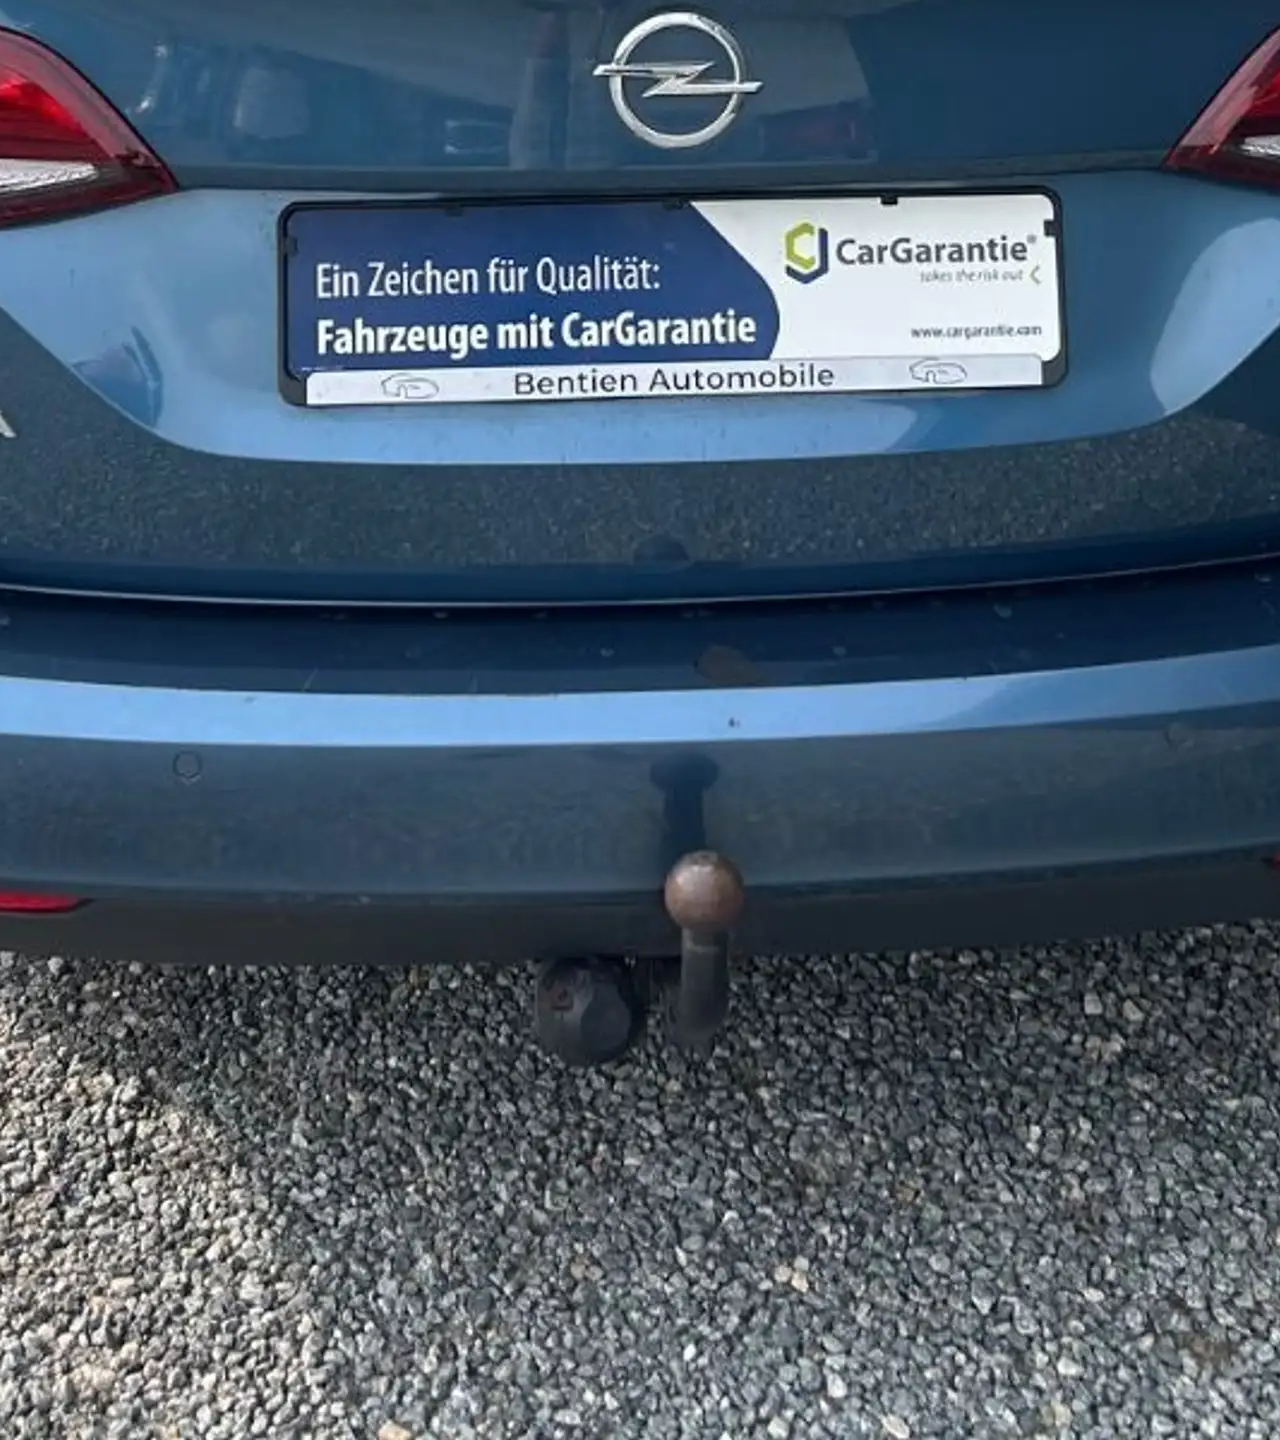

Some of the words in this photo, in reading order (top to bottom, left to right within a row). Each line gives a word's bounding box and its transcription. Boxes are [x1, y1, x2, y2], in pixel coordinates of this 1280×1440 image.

[316, 263, 360, 299] Ein
[367, 259, 479, 297] Zeichen
[487, 256, 529, 294] für
[536, 255, 661, 295] Qualität:
[317, 317, 489, 360] Fahrzeuge
[497, 312, 554, 350] mit
[561, 307, 757, 348] CarGarantie
[910, 324, 1042, 340] www.cargarantie.com
[514, 367, 638, 396] Bentien
[648, 361, 835, 392] Automobile
